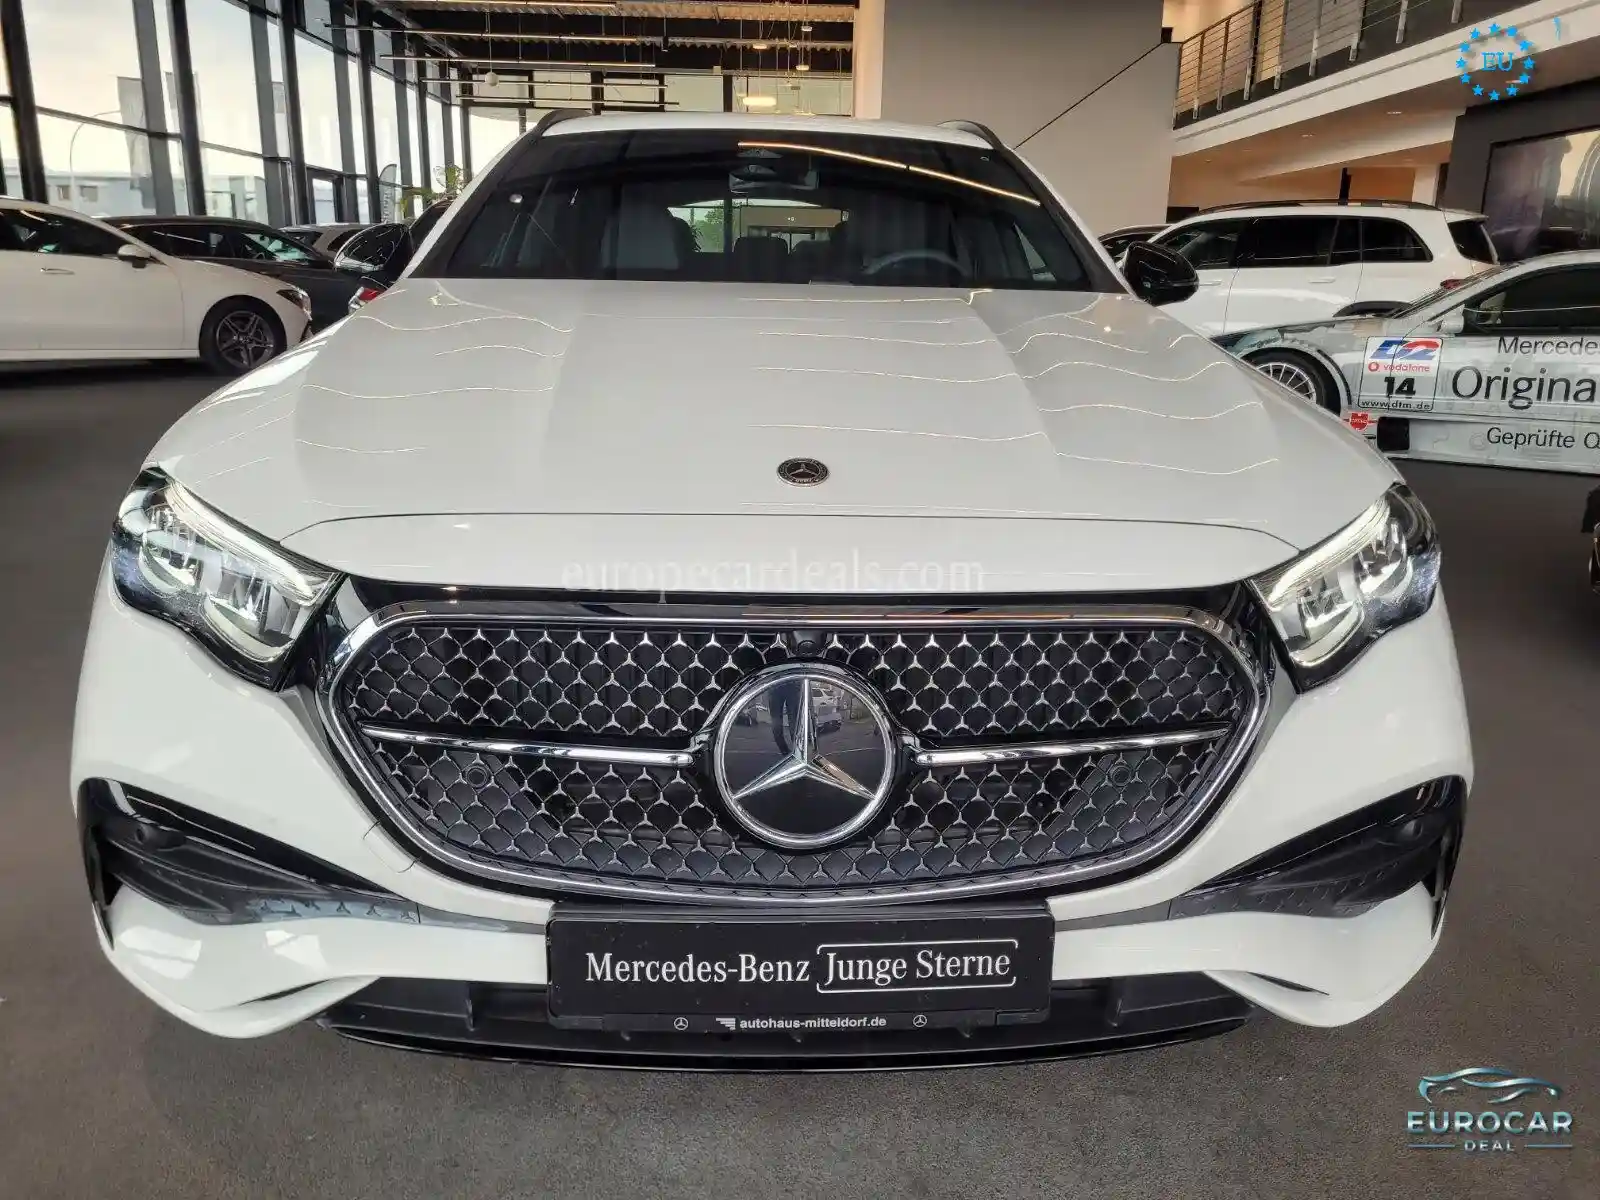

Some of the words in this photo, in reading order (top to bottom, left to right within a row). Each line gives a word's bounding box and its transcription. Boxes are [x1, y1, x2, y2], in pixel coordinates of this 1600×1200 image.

[1498, 336, 1600, 355] Mercede
[1383, 364, 1430, 372] vodafone
[1384, 376, 1416, 399] 14
[1361, 400, 1431, 410] www.dtm.de
[1487, 427, 1575, 449] Geprüfte
[585, 952, 810, 983] Mercedes-Benz
[824, 952, 907, 986] Junge
[916, 949, 1010, 978] Sterne
[739, 1016, 887, 1029] autohaus-mitteldorf.de
